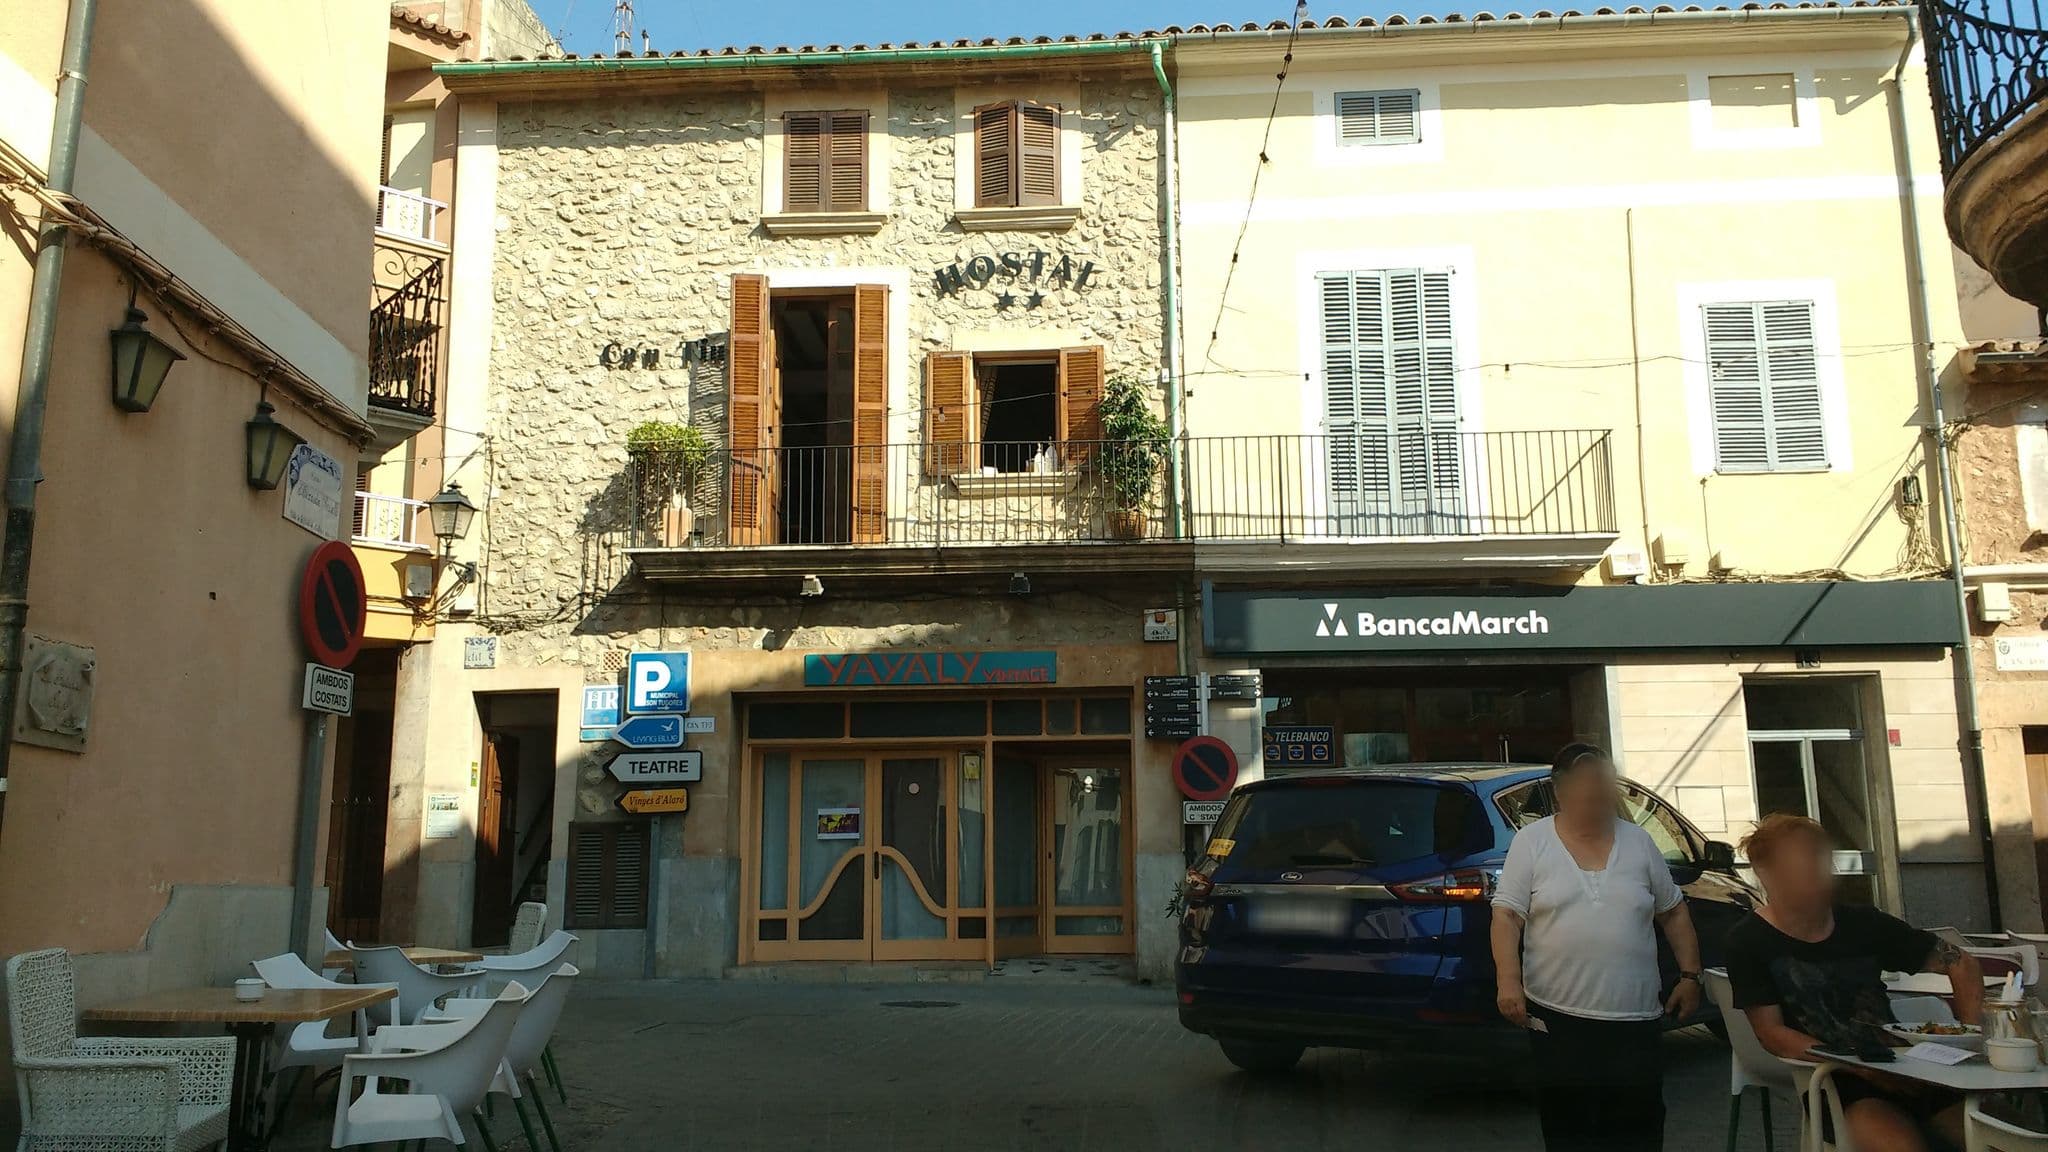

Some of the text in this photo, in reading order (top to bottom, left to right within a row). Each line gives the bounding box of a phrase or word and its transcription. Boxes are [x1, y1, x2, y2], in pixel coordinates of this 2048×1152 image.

[935, 252, 1095, 298] HOSTAL
[599, 342, 659, 370] Can
[1357, 610, 1549, 637] BancaMarch
[820, 653, 982, 684] YAYALY
[316, 673, 348, 690] AMBDOS
[634, 660, 671, 707] P
[315, 690, 347, 707] COSTATS
[1275, 731, 1329, 742] TELEBANCO
[628, 760, 689, 774] TEATRE
[629, 796, 654, 806] Vinyes
[1189, 804, 1223, 812] AMBDOS
[1189, 813, 1220, 821] CSTAT
